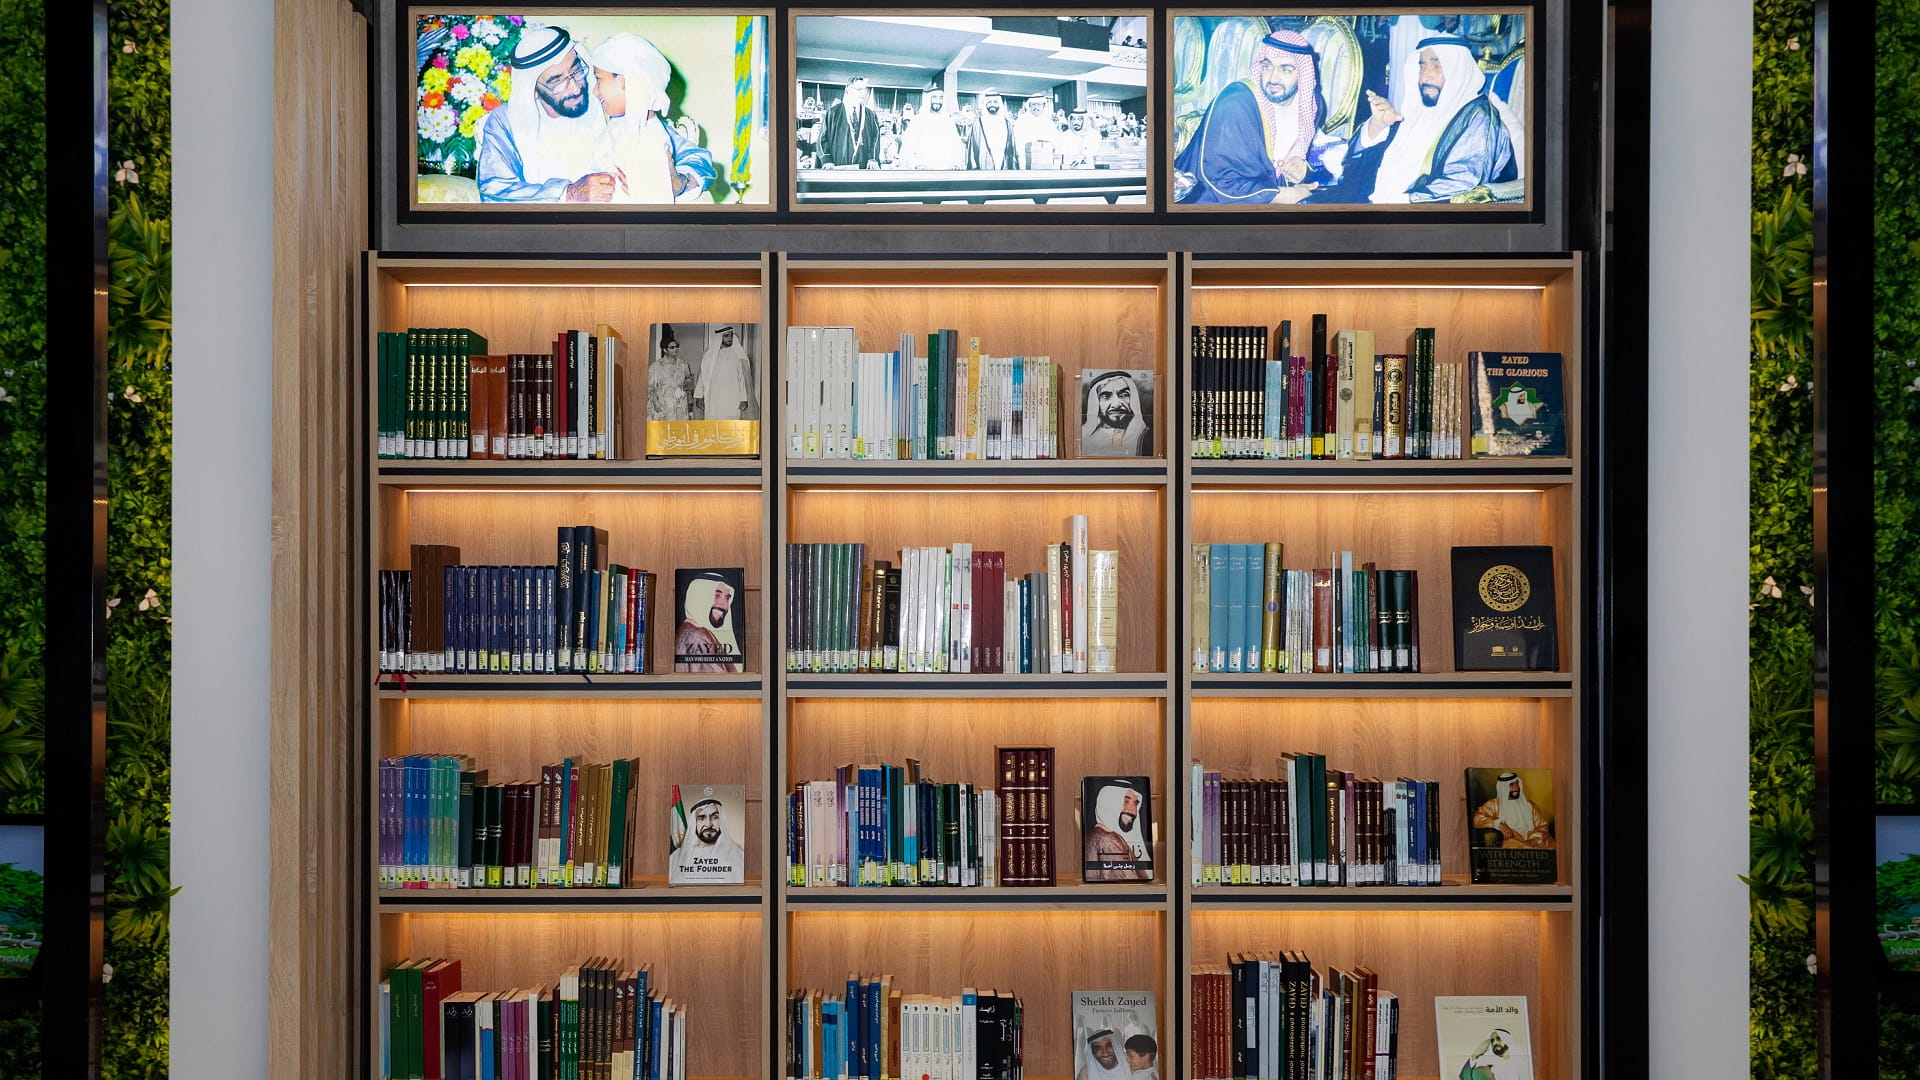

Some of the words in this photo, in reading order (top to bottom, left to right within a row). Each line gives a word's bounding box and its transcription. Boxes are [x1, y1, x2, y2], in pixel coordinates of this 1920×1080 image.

[1502, 356, 1529, 364] ZAYED
[1486, 368, 1504, 376] THE
[1506, 368, 1548, 377] GLORIOUS
[686, 644, 733, 654] ZAYED
[1510, 851, 1549, 859] UNITED
[1080, 996, 1114, 1006] Sheikh
[1118, 996, 1146, 1008] Zayed
